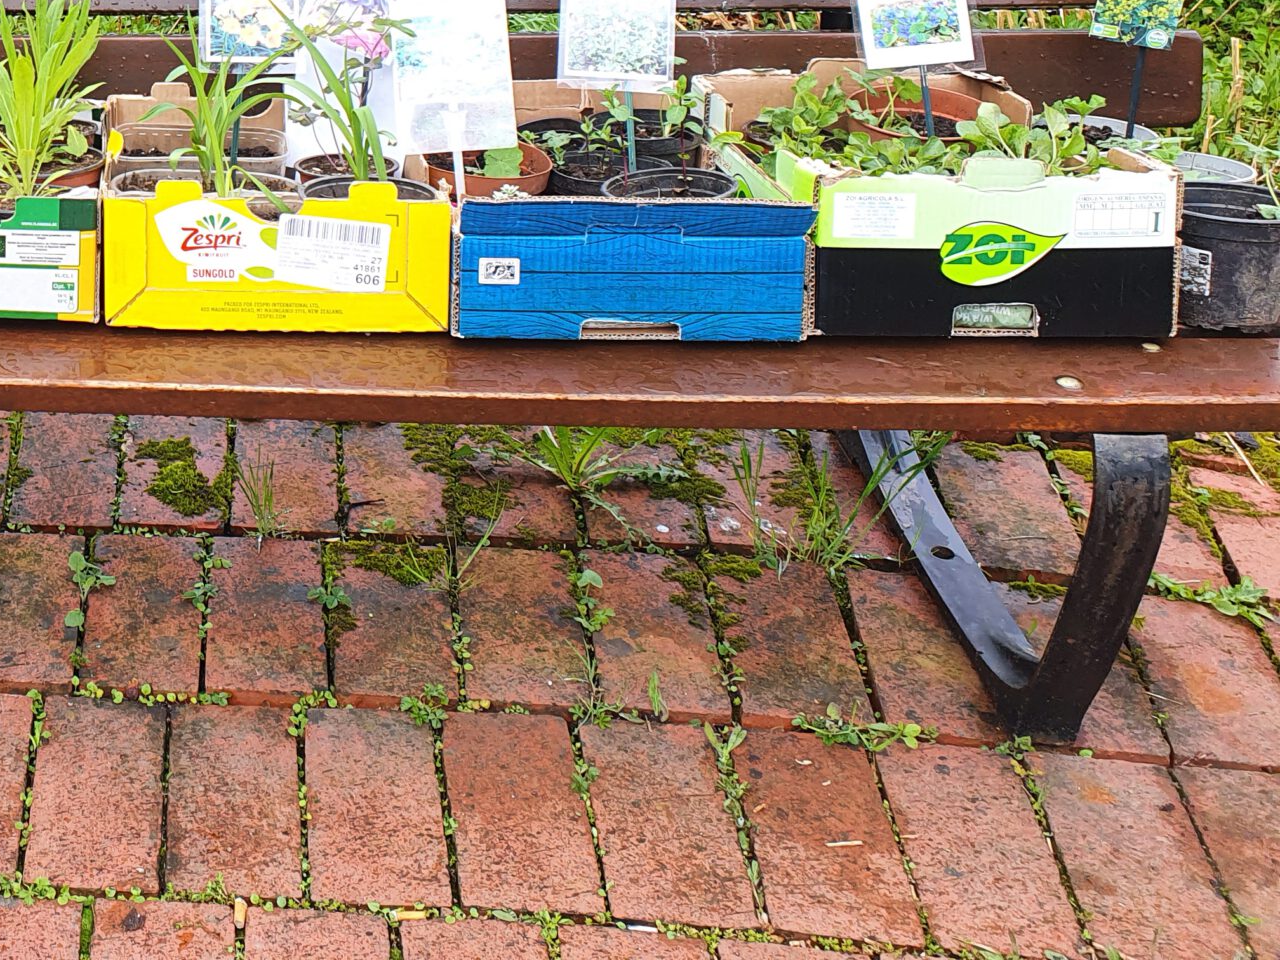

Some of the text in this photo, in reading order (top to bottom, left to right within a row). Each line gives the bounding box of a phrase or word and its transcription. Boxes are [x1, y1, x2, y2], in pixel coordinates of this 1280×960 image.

[180, 226, 243, 252] Zespri
[371, 257, 383, 265] 27
[192, 268, 235, 279] SUNGOLD
[353, 264, 381, 273] 41861
[355, 273, 381, 286] 606
